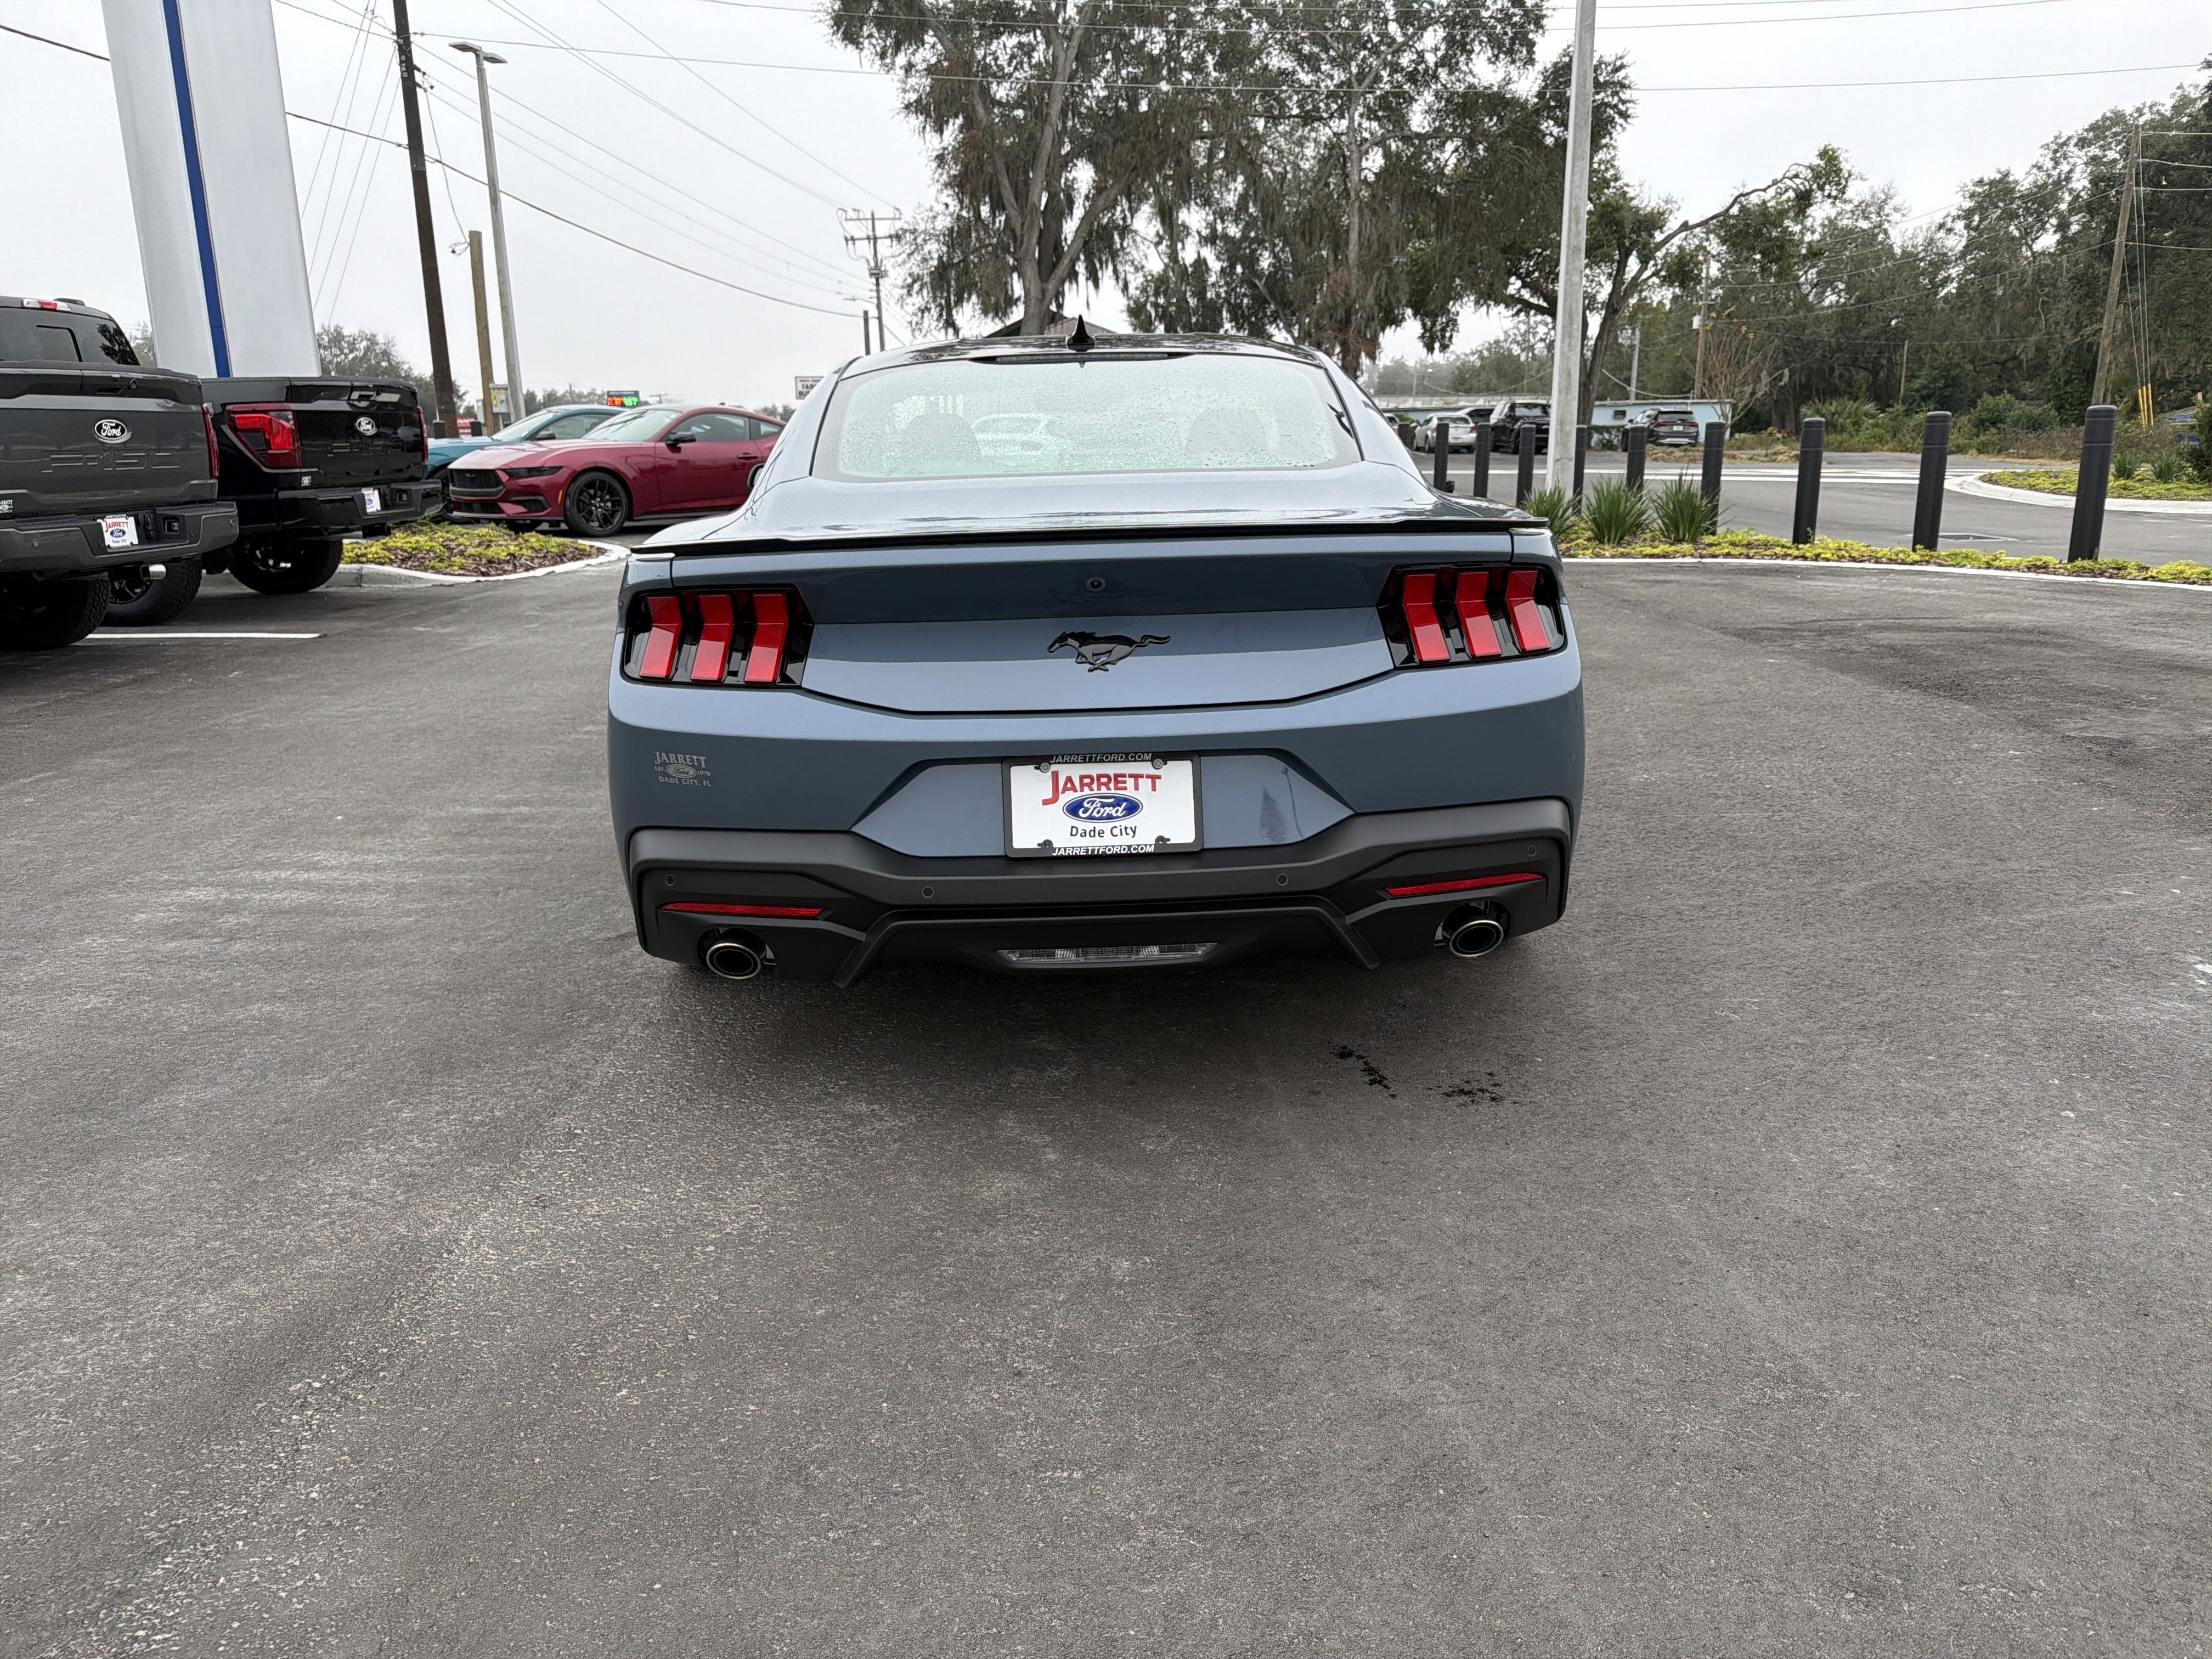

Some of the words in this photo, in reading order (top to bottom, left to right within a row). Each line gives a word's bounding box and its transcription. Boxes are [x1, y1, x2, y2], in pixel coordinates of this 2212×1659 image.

[101, 422, 121, 436] Ford
[105, 521, 128, 533] JARRETT
[654, 752, 707, 768] JARRETT
[1050, 753, 1152, 763] JARRETTFORD.COM
[673, 767, 690, 775] Ford
[681, 778, 701, 787] CITY,
[1042, 770, 1161, 805] JARRETT
[1079, 798, 1127, 817] Ford
[1070, 826, 1105, 838] Dade
[1110, 825, 1137, 838] City
[1052, 844, 1154, 856] JARRETTFORD.COM
